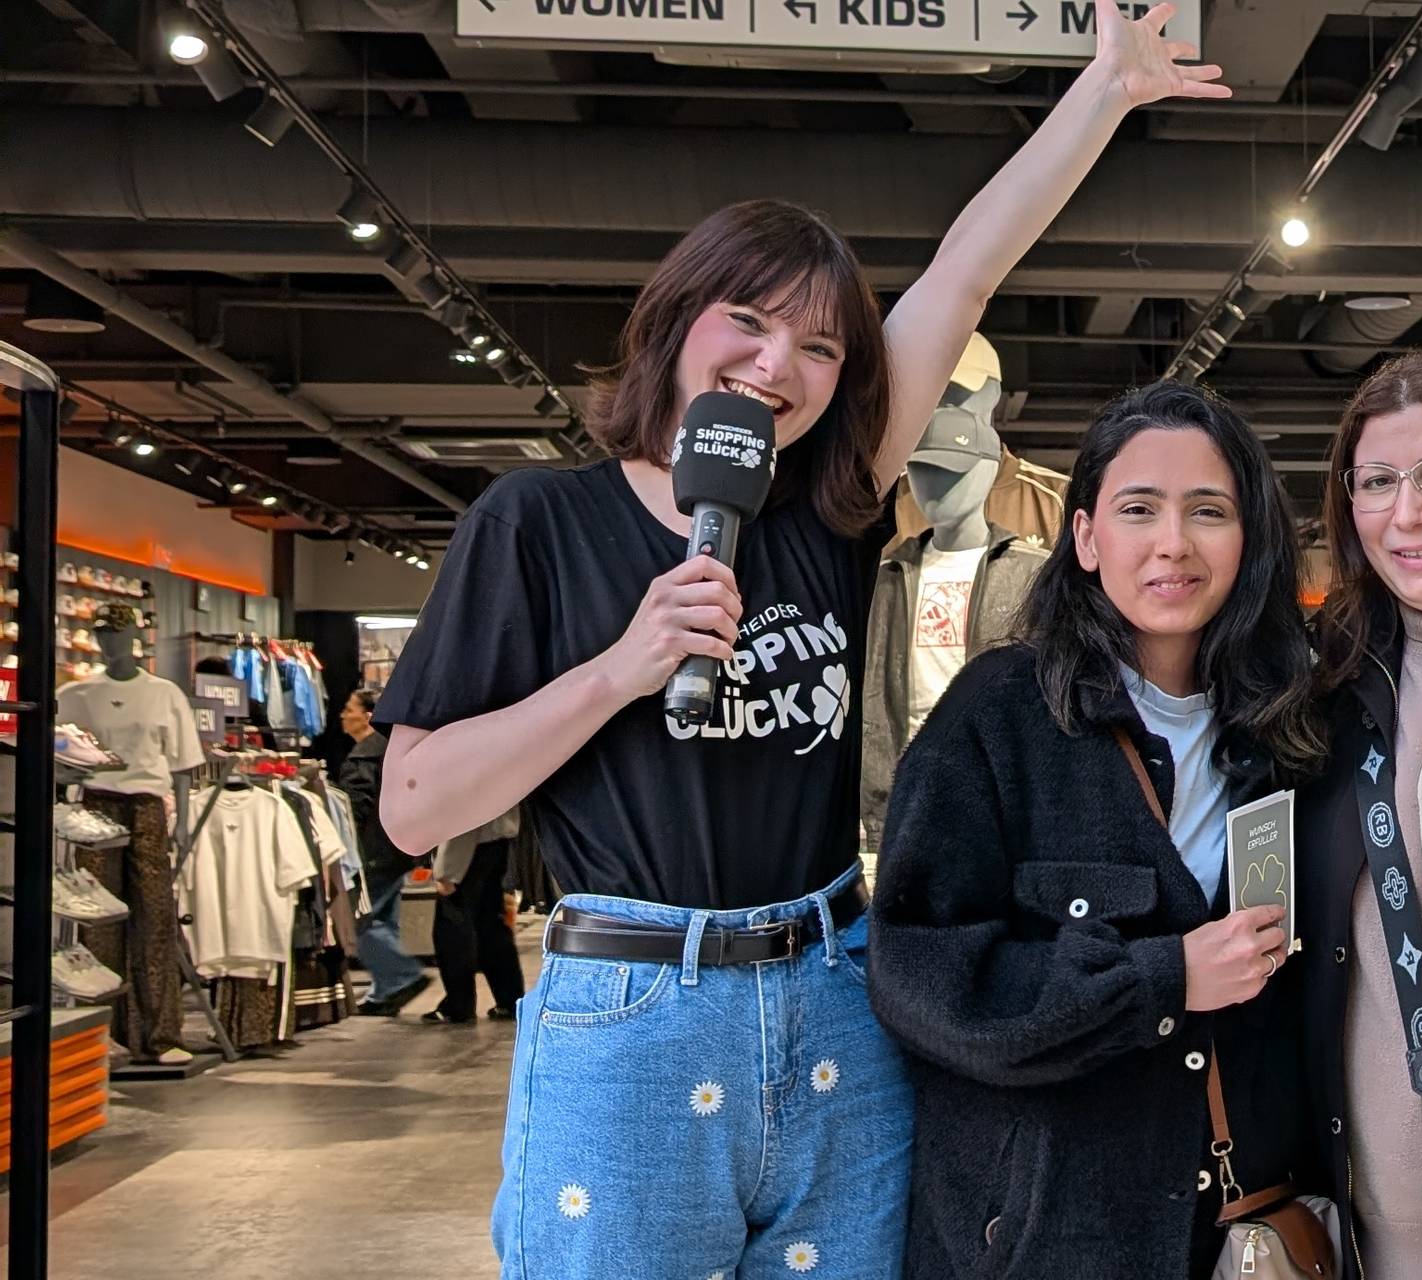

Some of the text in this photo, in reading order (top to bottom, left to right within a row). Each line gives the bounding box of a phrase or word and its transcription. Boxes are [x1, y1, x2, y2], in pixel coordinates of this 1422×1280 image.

[535, 0, 724, 20] WOMEN
[839, 0, 945, 28] KIDS
[694, 441, 741, 459] GLÜCK
[696, 428, 766, 450] SHOPPING
